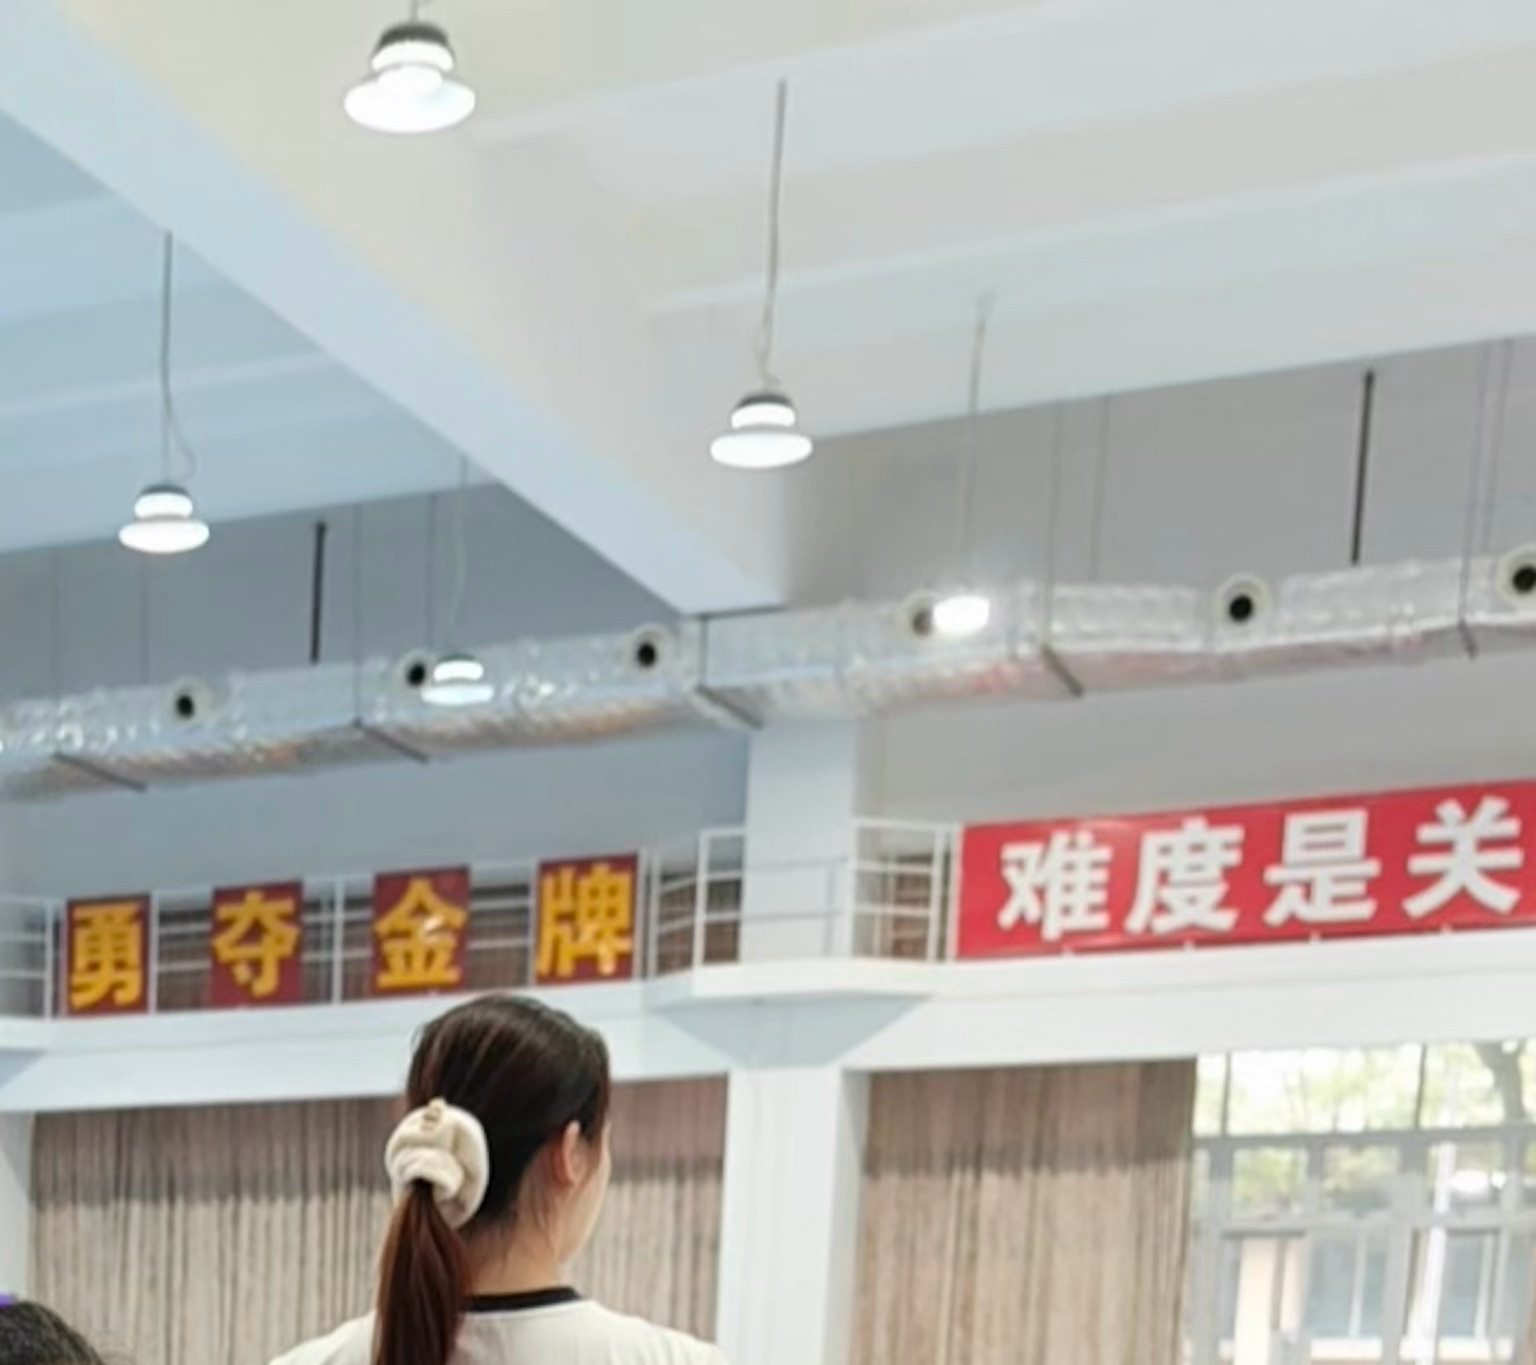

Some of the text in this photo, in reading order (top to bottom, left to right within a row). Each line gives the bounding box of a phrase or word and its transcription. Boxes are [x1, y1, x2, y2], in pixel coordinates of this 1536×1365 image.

[68, 863, 636, 1007] 勇夺金牌
[997, 796, 1524, 942] 难度是关
